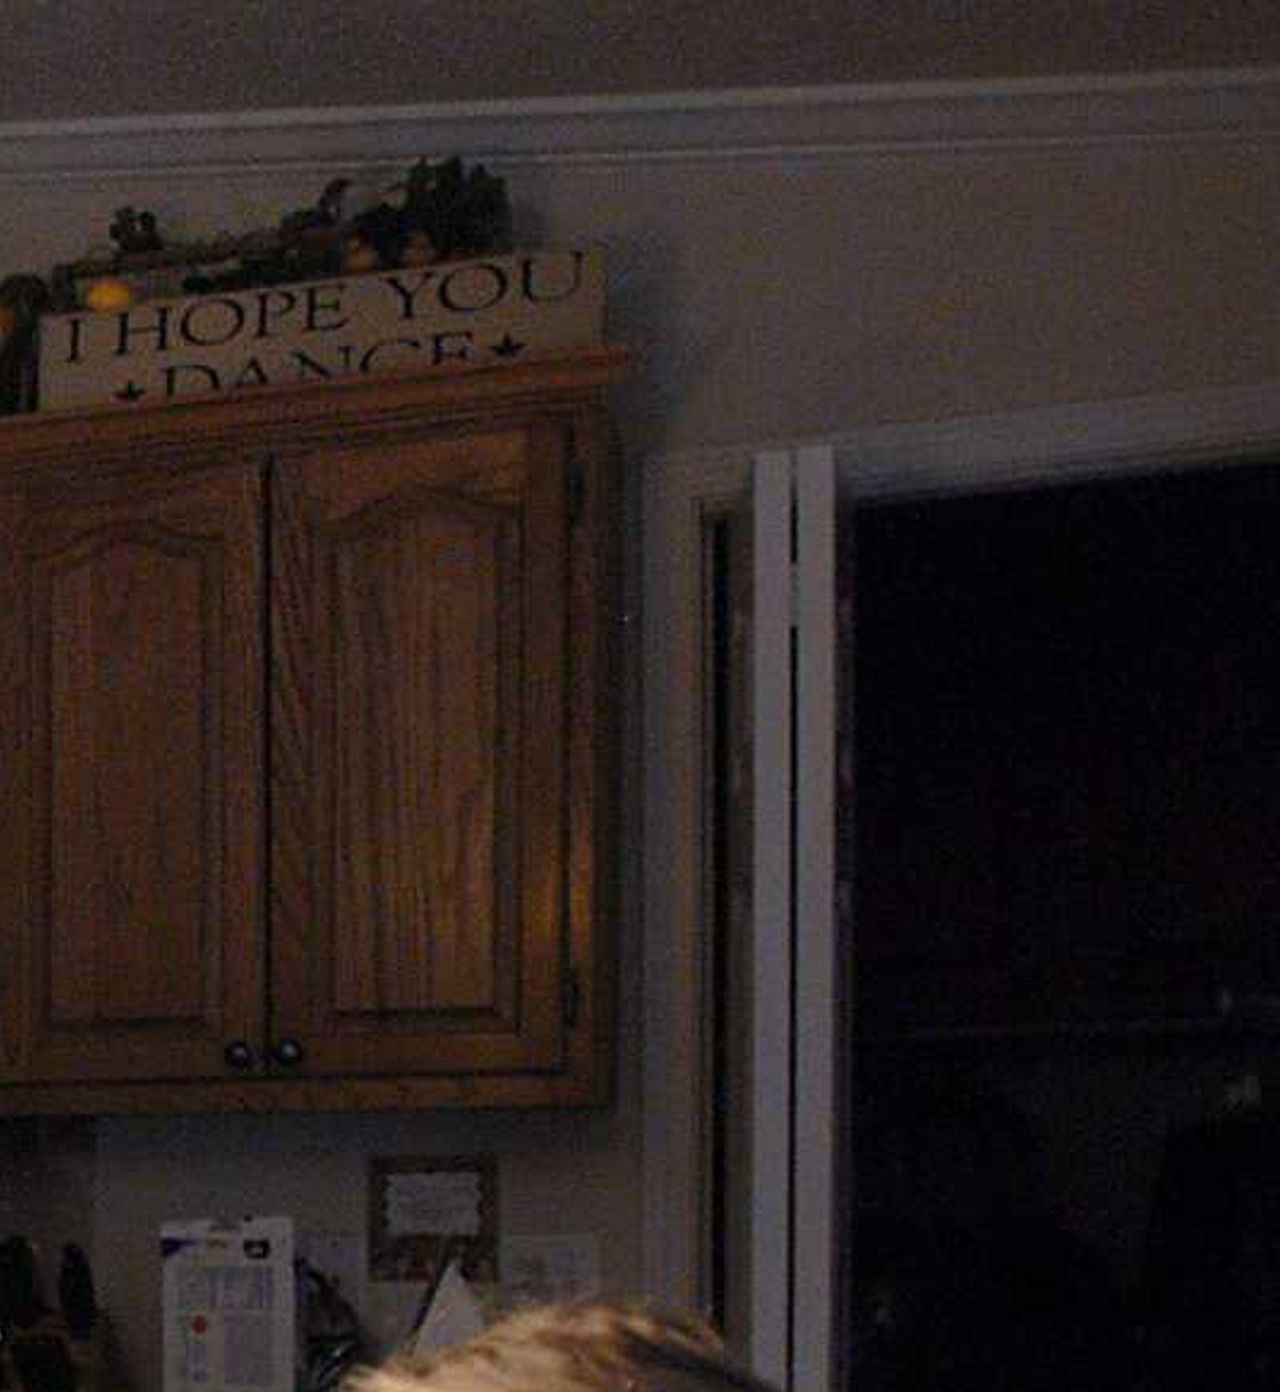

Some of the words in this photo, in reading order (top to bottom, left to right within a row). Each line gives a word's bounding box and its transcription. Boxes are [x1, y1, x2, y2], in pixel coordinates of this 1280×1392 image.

[67, 319, 83, 363] I
[116, 286, 346, 355] HOPE
[386, 251, 584, 319] YOU
